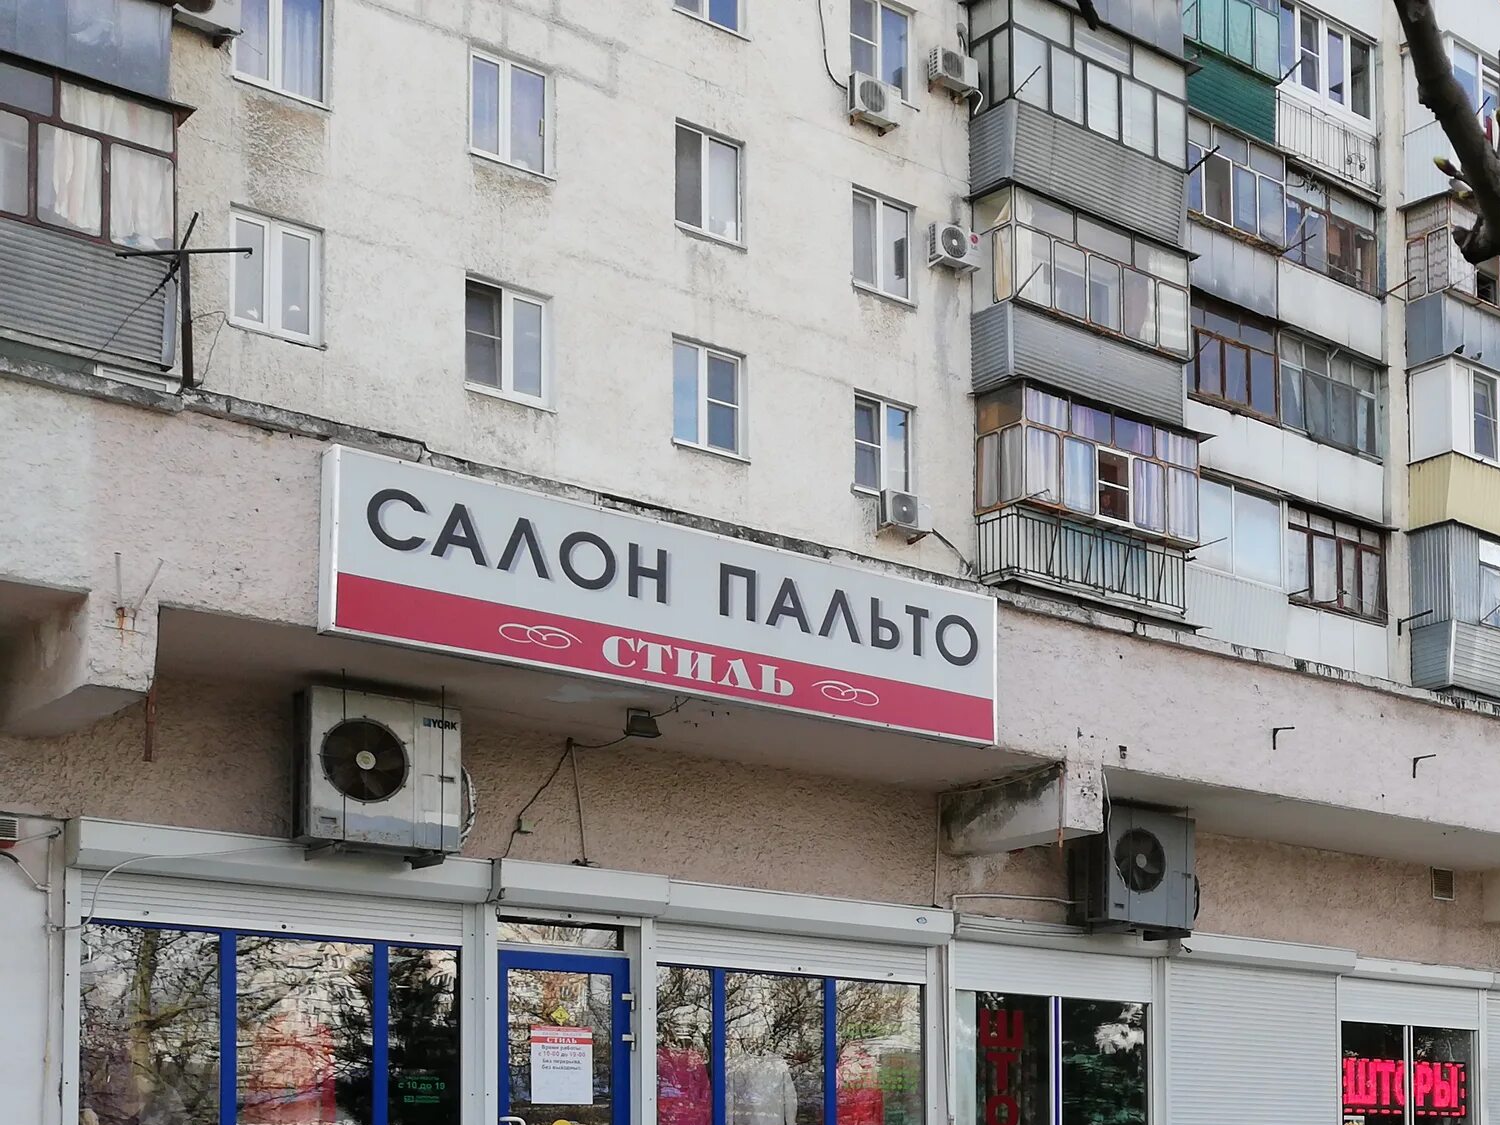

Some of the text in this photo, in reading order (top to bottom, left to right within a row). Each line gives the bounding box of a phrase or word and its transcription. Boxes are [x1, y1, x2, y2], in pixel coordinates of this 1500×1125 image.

[366, 487, 979, 667] САЛОН ПАЛЬТО
[602, 635, 795, 697] СТИЛЬ
[432, 718, 458, 731] YORK
[1345, 1061, 1459, 1108] ШТОРЫ
